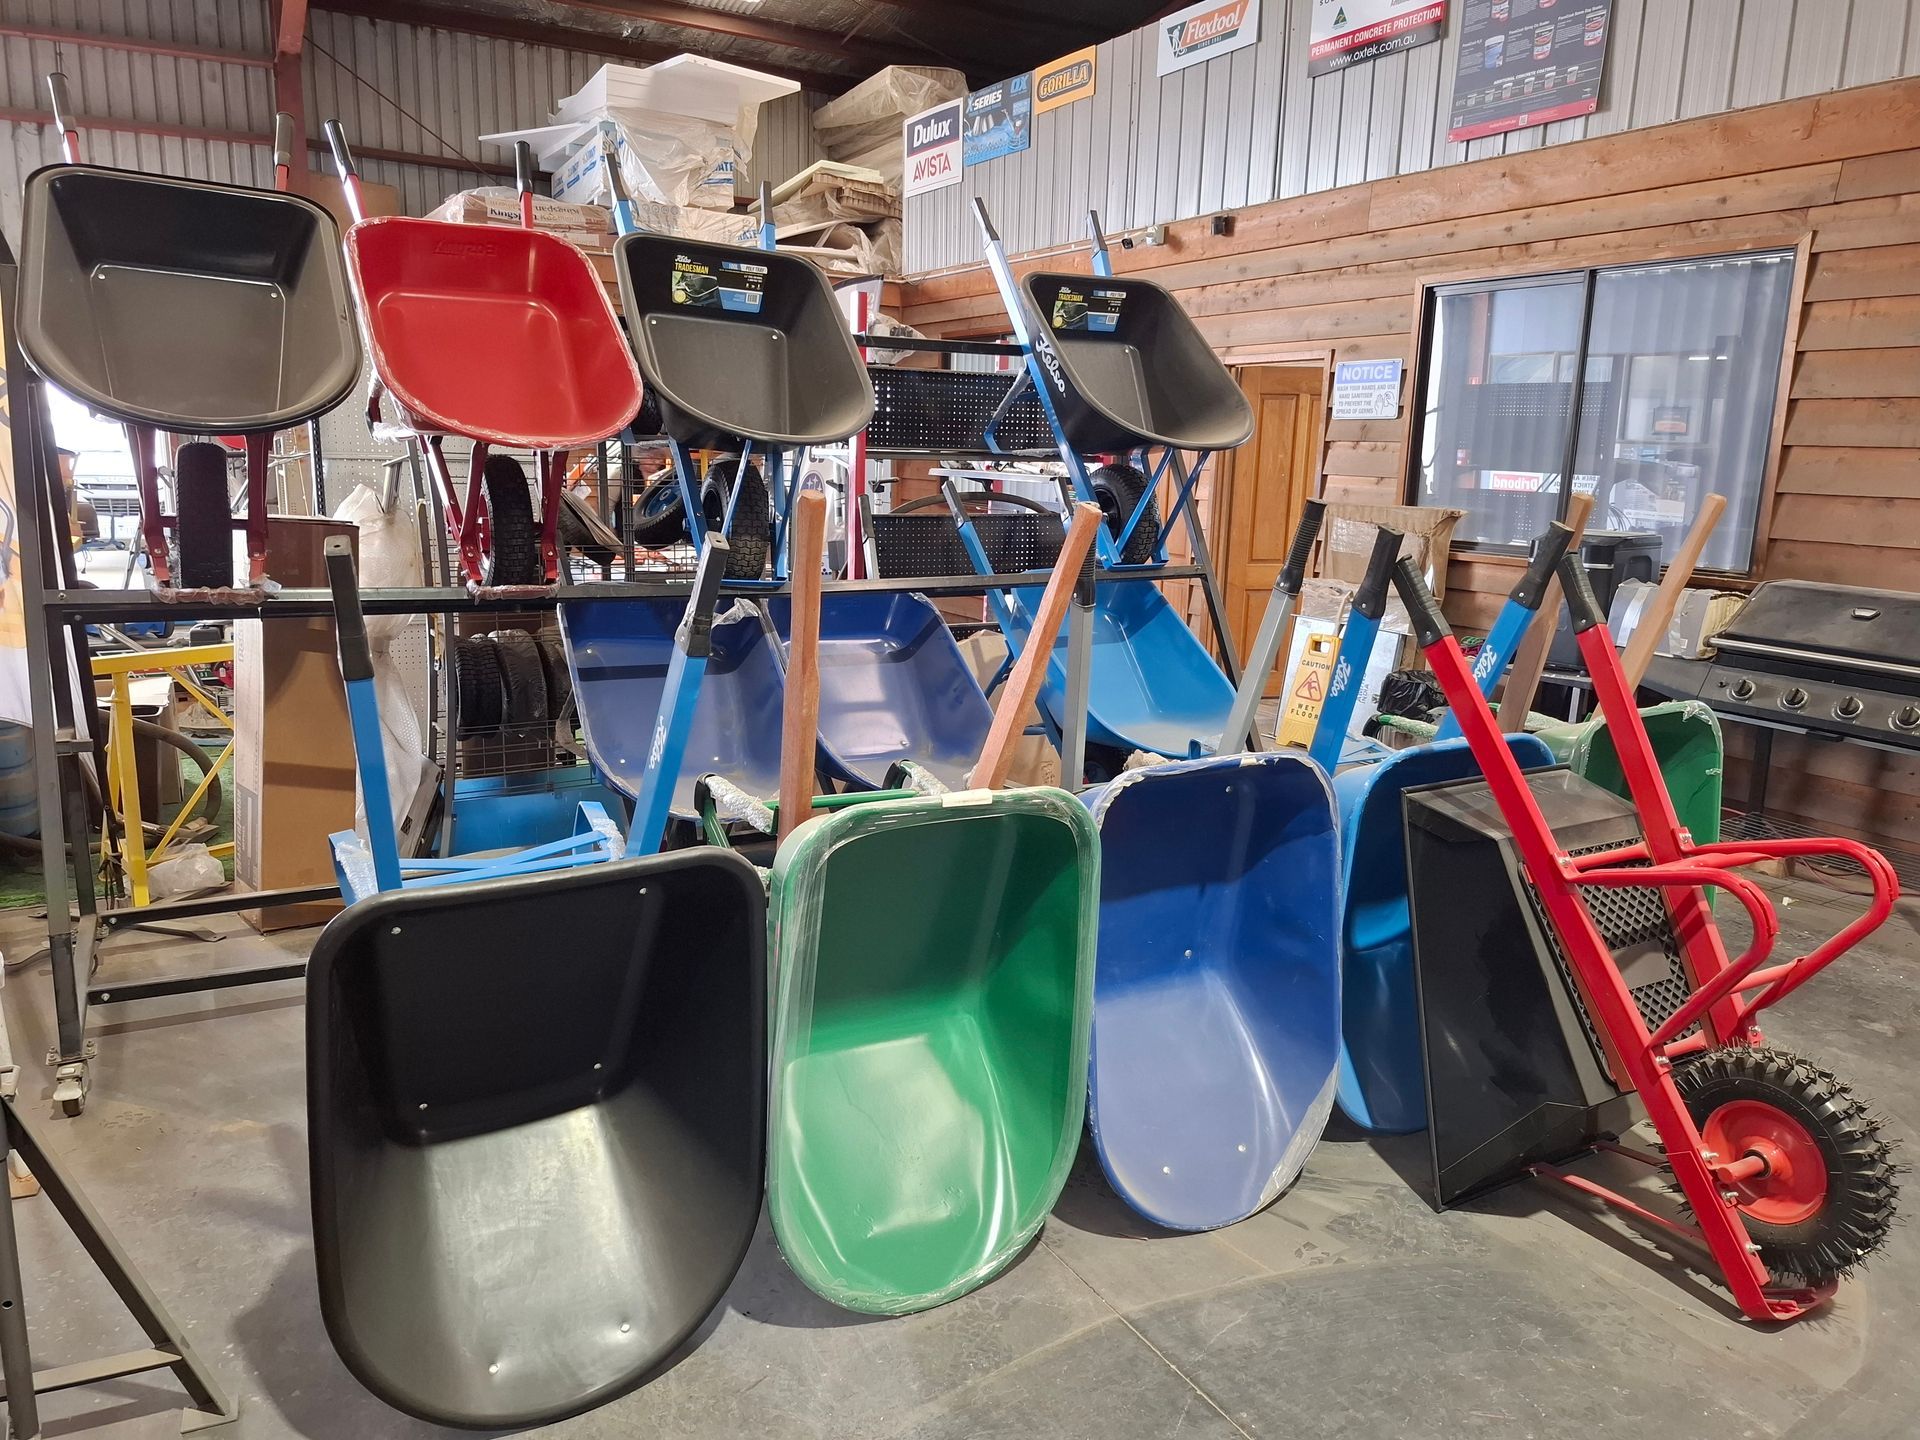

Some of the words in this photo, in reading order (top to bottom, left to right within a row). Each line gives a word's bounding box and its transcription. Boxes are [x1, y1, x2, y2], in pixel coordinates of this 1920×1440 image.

[1186, 4, 1241, 42] Flextool
[1311, 35, 1353, 57] PERMANENT
[1354, 24, 1392, 43] CONCRETE
[1393, 6, 1442, 29] PROTECTION
[1329, 33, 1417, 68] www.oxtek.com.au
[1010, 75, 1029, 93] OX
[1040, 62, 1090, 97] GORILLA
[966, 89, 1003, 114] X-SERIES
[913, 119, 951, 148] Dulux
[913, 152, 952, 183] AVISTA
[674, 262, 709, 275] TRADESMAN
[1342, 364, 1394, 380] NOTICE
[1301, 659, 1331, 671] CAUTION
[1472, 644, 1497, 683] Kels
[1290, 708, 1319, 719] FLOOR
[1297, 703, 1316, 712] WET
